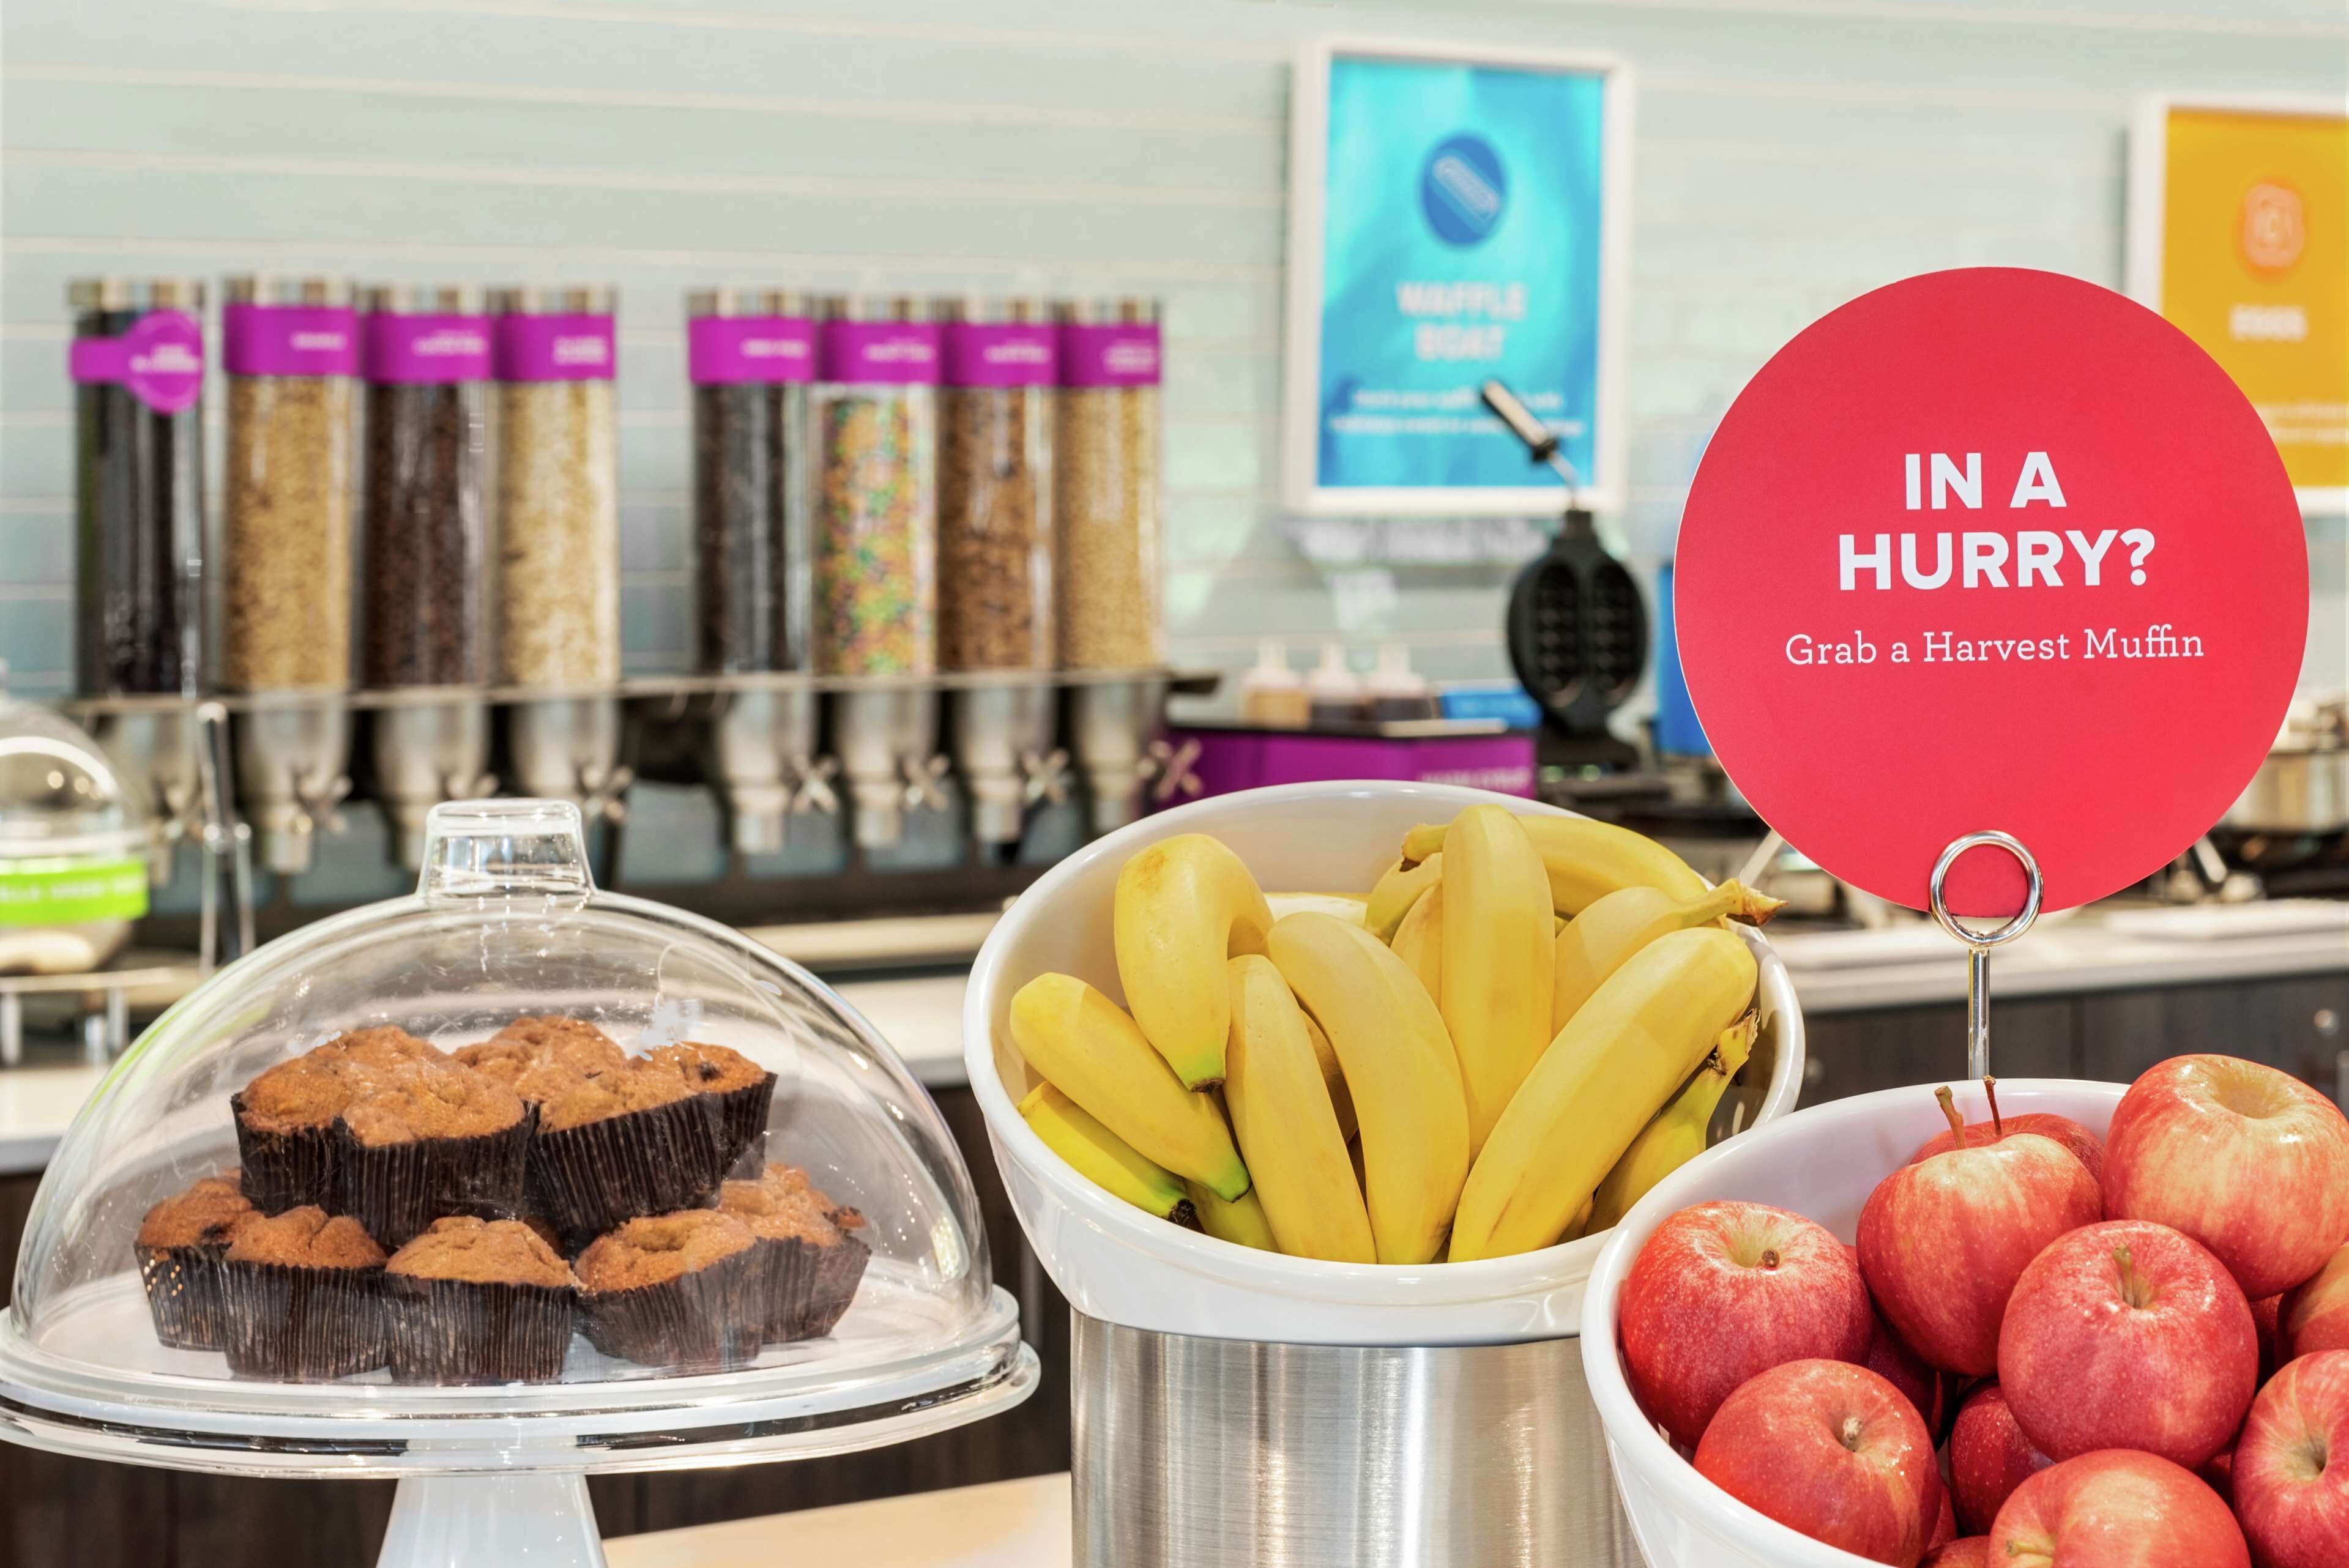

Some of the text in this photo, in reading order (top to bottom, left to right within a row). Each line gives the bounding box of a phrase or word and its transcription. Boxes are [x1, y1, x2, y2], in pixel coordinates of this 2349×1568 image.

[1398, 284, 1526, 319] WAFFLE
[1415, 325, 1504, 360] BOAT
[1905, 451, 2067, 510] IN A
[1839, 528, 2155, 591] HURRY?
[1785, 624, 2204, 665] Grab a Harvest Muffin
